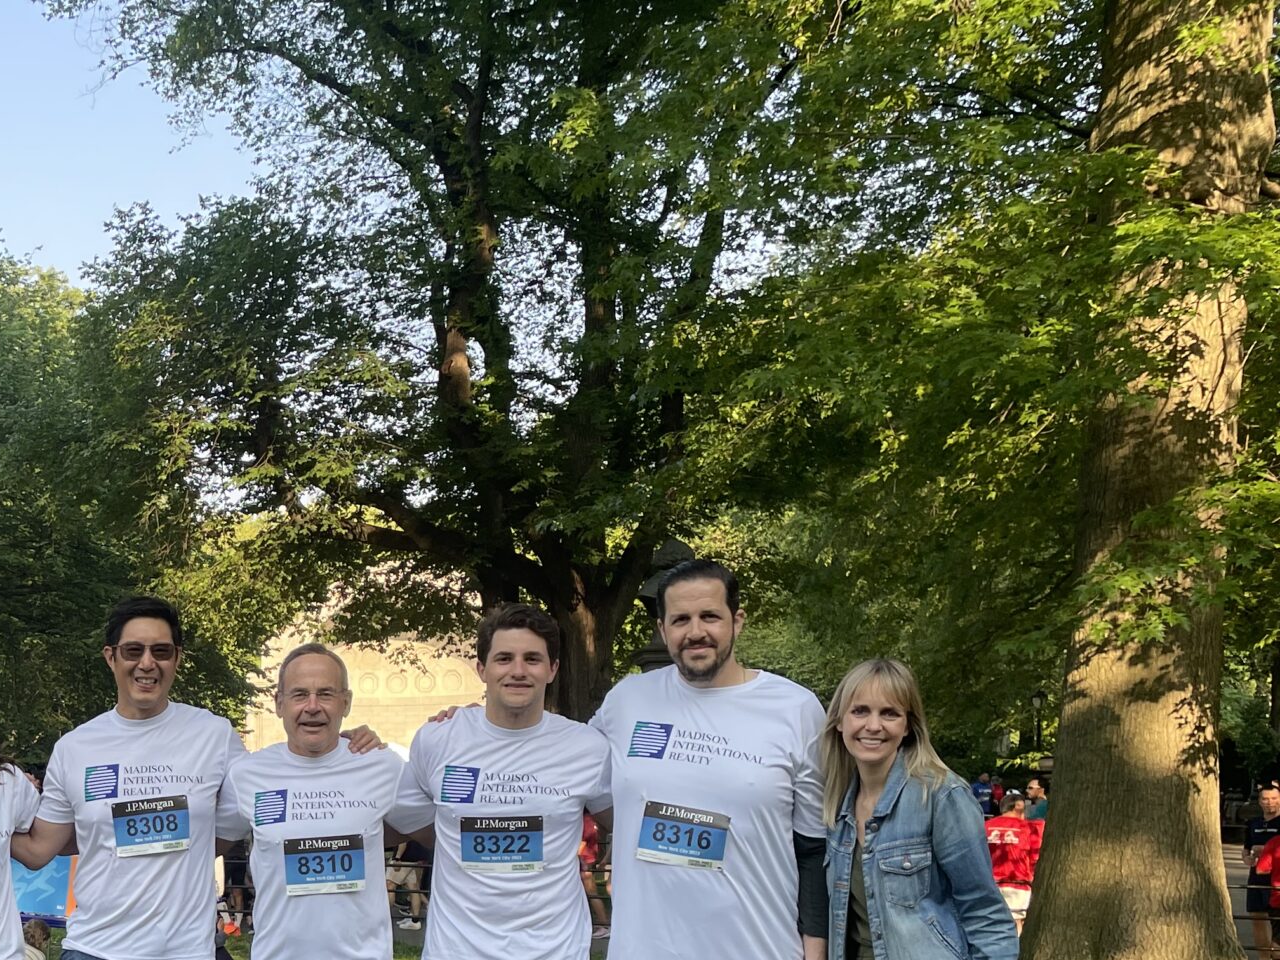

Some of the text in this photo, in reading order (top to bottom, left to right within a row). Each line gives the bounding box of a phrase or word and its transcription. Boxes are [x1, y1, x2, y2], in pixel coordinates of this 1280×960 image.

[676, 730, 730, 745] MADISON
[672, 740, 765, 765] INTERNATIONAL
[669, 752, 713, 766] REALTY
[124, 765, 173, 774] MADISON
[124, 775, 205, 785] INTERNATIONAL
[484, 772, 538, 782] MADISON
[123, 787, 162, 796] REALTY
[291, 790, 344, 799] MADISON
[481, 784, 571, 796] INTERNATIONAL
[291, 800, 377, 810] INTERNATIONAL
[480, 795, 526, 805] REALTY
[126, 800, 174, 812] J.P.Morgan
[291, 811, 336, 820] REALTY
[659, 805, 714, 823] J.P.Morgan
[126, 814, 178, 836] 8308
[475, 819, 528, 830] J.P.Morgan
[653, 822, 712, 849] 8316
[298, 839, 349, 850] J.P.Morgan
[473, 835, 530, 854] 8322
[298, 853, 352, 875] 8310
